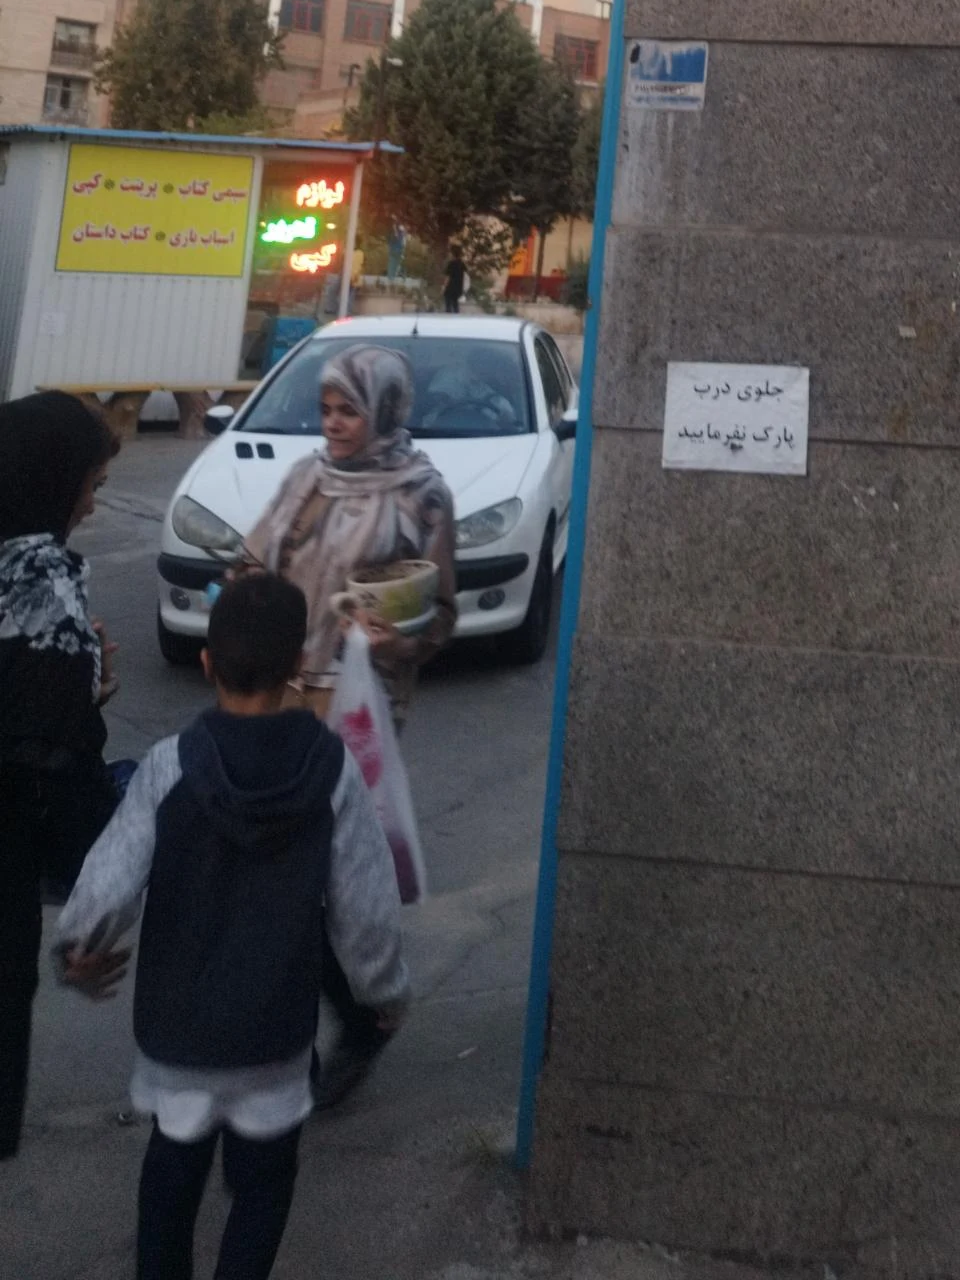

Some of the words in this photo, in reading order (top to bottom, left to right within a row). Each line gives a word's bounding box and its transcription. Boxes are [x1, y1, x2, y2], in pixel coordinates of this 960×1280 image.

[72, 173, 103, 195] کپی
[119, 178, 158, 198] پرینت
[178, 179, 210, 198] کتاب
[296, 179, 345, 209] لوازم
[72, 223, 117, 243] داستان
[120, 225, 151, 244] کتاب
[290, 243, 337, 274] کپی
[693, 381, 731, 400] درب
[736, 380, 784, 403] جلوی
[677, 422, 747, 448] نفرمایید
[752, 425, 796, 451] پارک
